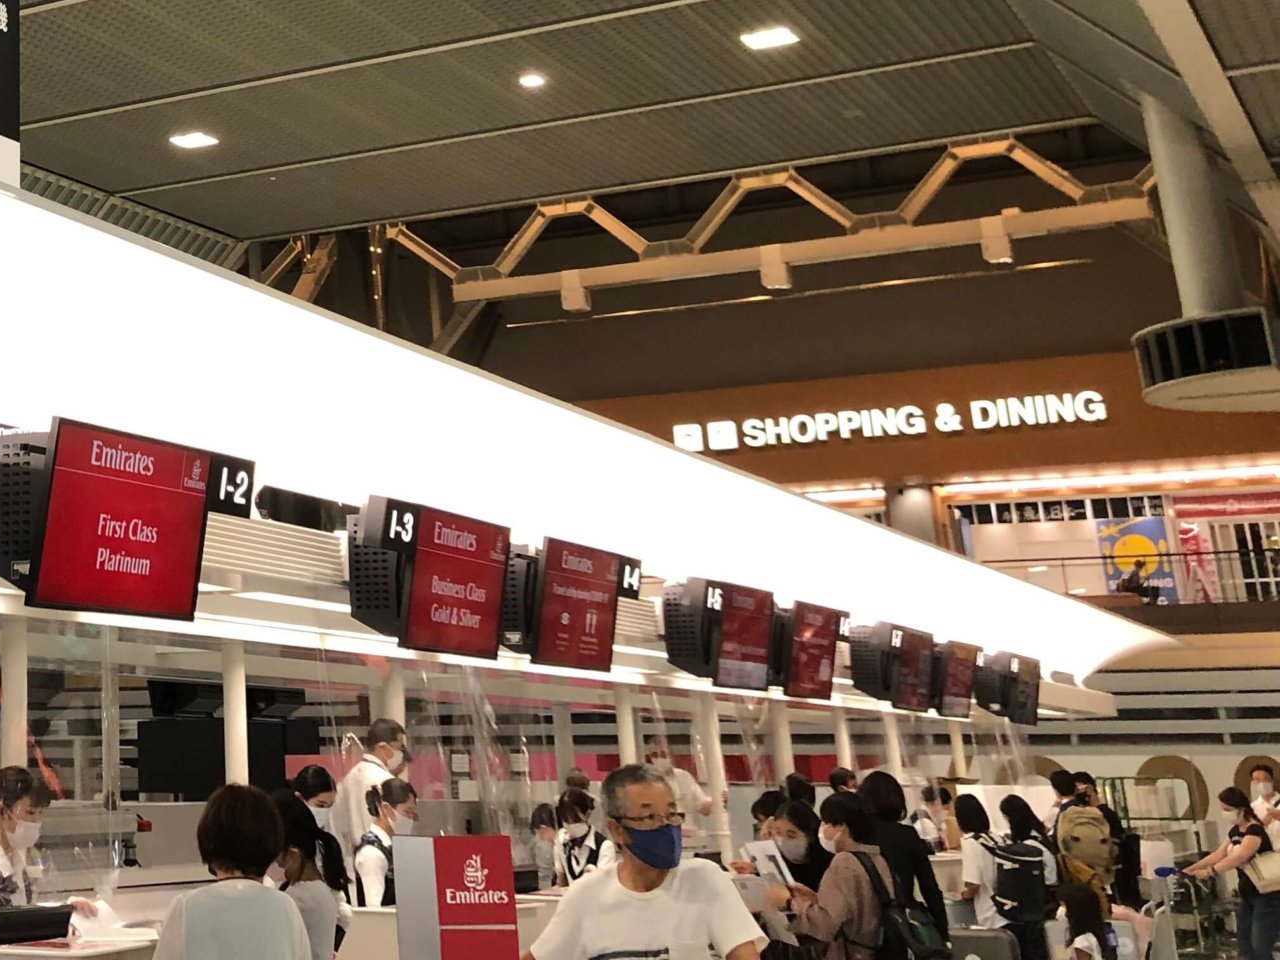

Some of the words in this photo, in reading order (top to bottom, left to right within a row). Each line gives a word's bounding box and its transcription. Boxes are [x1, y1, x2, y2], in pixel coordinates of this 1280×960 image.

[742, 405, 927, 447] SHOPPING
[935, 403, 964, 432] &
[969, 390, 1108, 430] DINING
[91, 440, 155, 476] Emirates
[184, 477, 206, 490] Emirates
[219, 466, 249, 505] I-2
[97, 513, 127, 539] First
[128, 518, 158, 544] Class
[389, 510, 414, 542] I-3
[434, 521, 477, 552] Emirates
[96, 547, 151, 576] Platinum
[431, 575, 465, 600] Business
[466, 582, 487, 603] Class
[431, 603, 451, 625] Gold
[451, 611, 459, 625] &
[459, 609, 482, 629] Silver
[446, 887, 509, 905] Emirates
